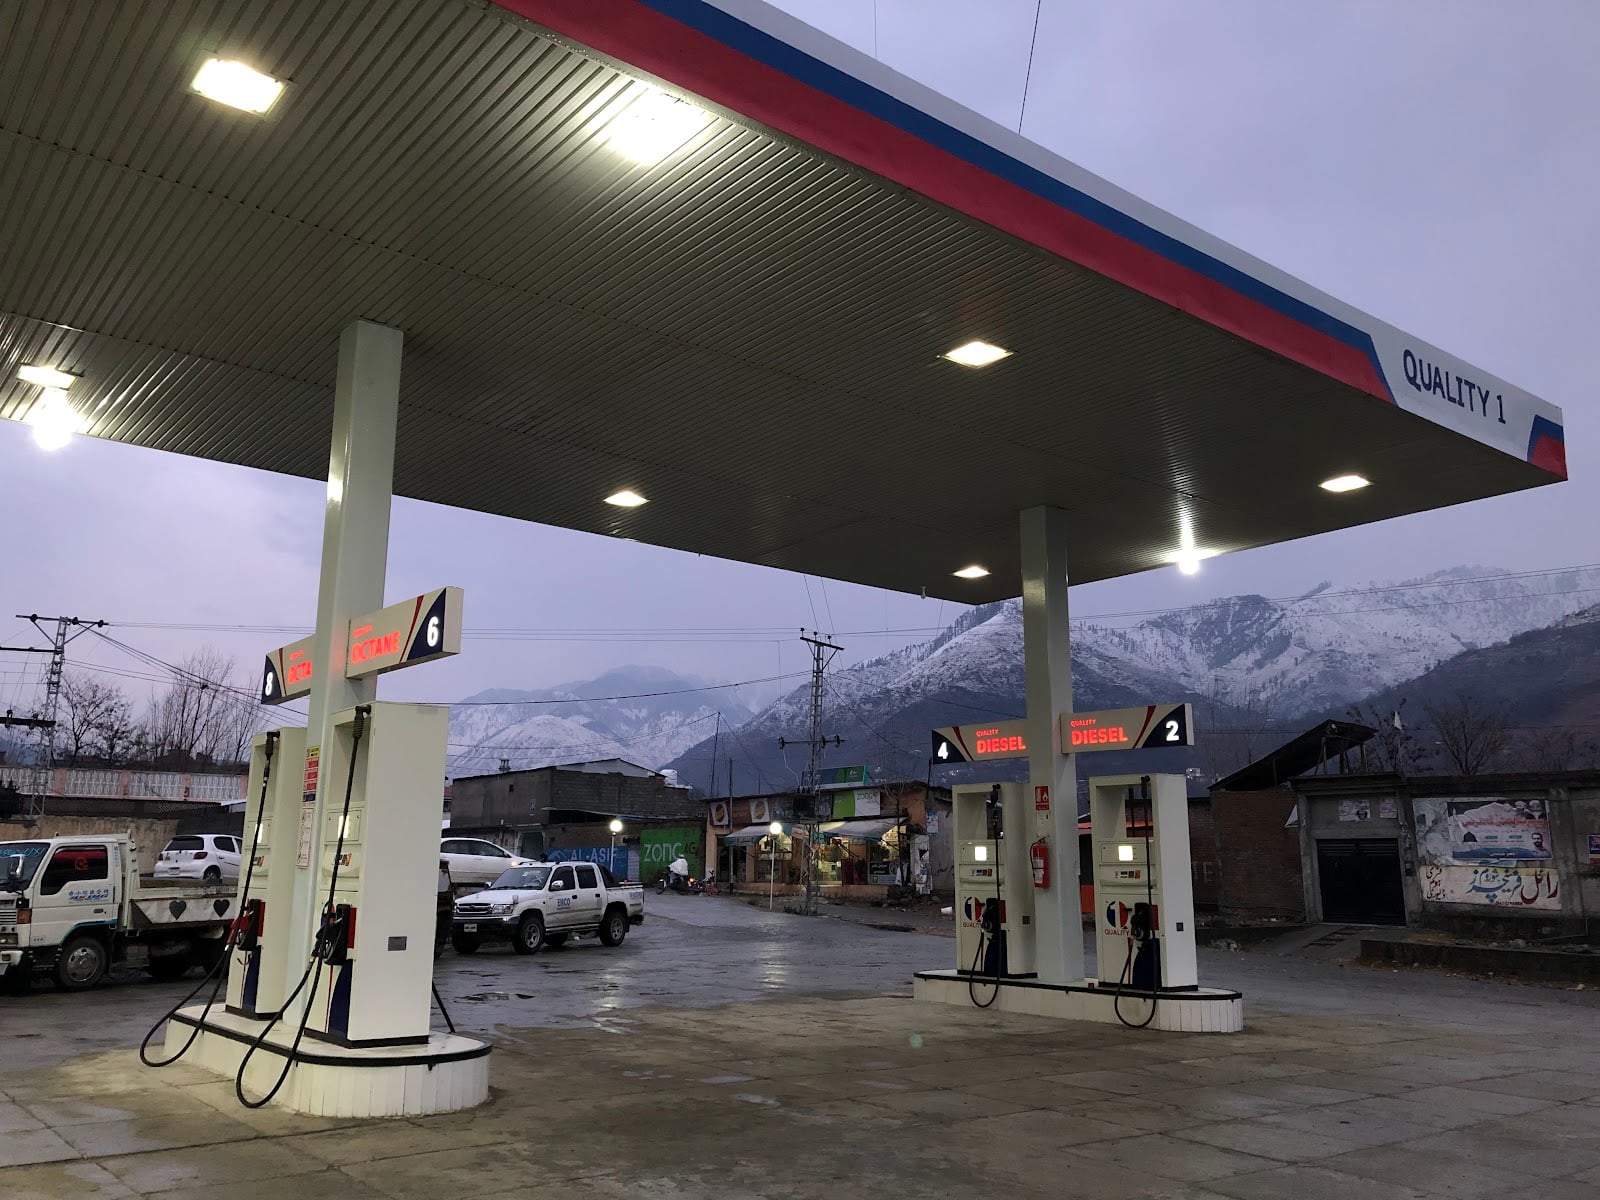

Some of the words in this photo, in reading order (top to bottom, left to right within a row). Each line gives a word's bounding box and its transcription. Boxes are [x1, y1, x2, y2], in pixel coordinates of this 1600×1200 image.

[1402, 349, 1490, 417] QUALITY
[1496, 394, 1506, 424] 1
[427, 616, 439, 647] 6
[351, 631, 400, 663] OCTANE
[265, 671, 273, 696] 8
[976, 729, 998, 737] QUALITY
[1070, 719, 1096, 727] QUALITY
[1165, 720, 1180, 742] 2
[976, 736, 1026, 754] DIESEL
[1071, 727, 1128, 745] DIESEL
[937, 741, 949, 760] 4
